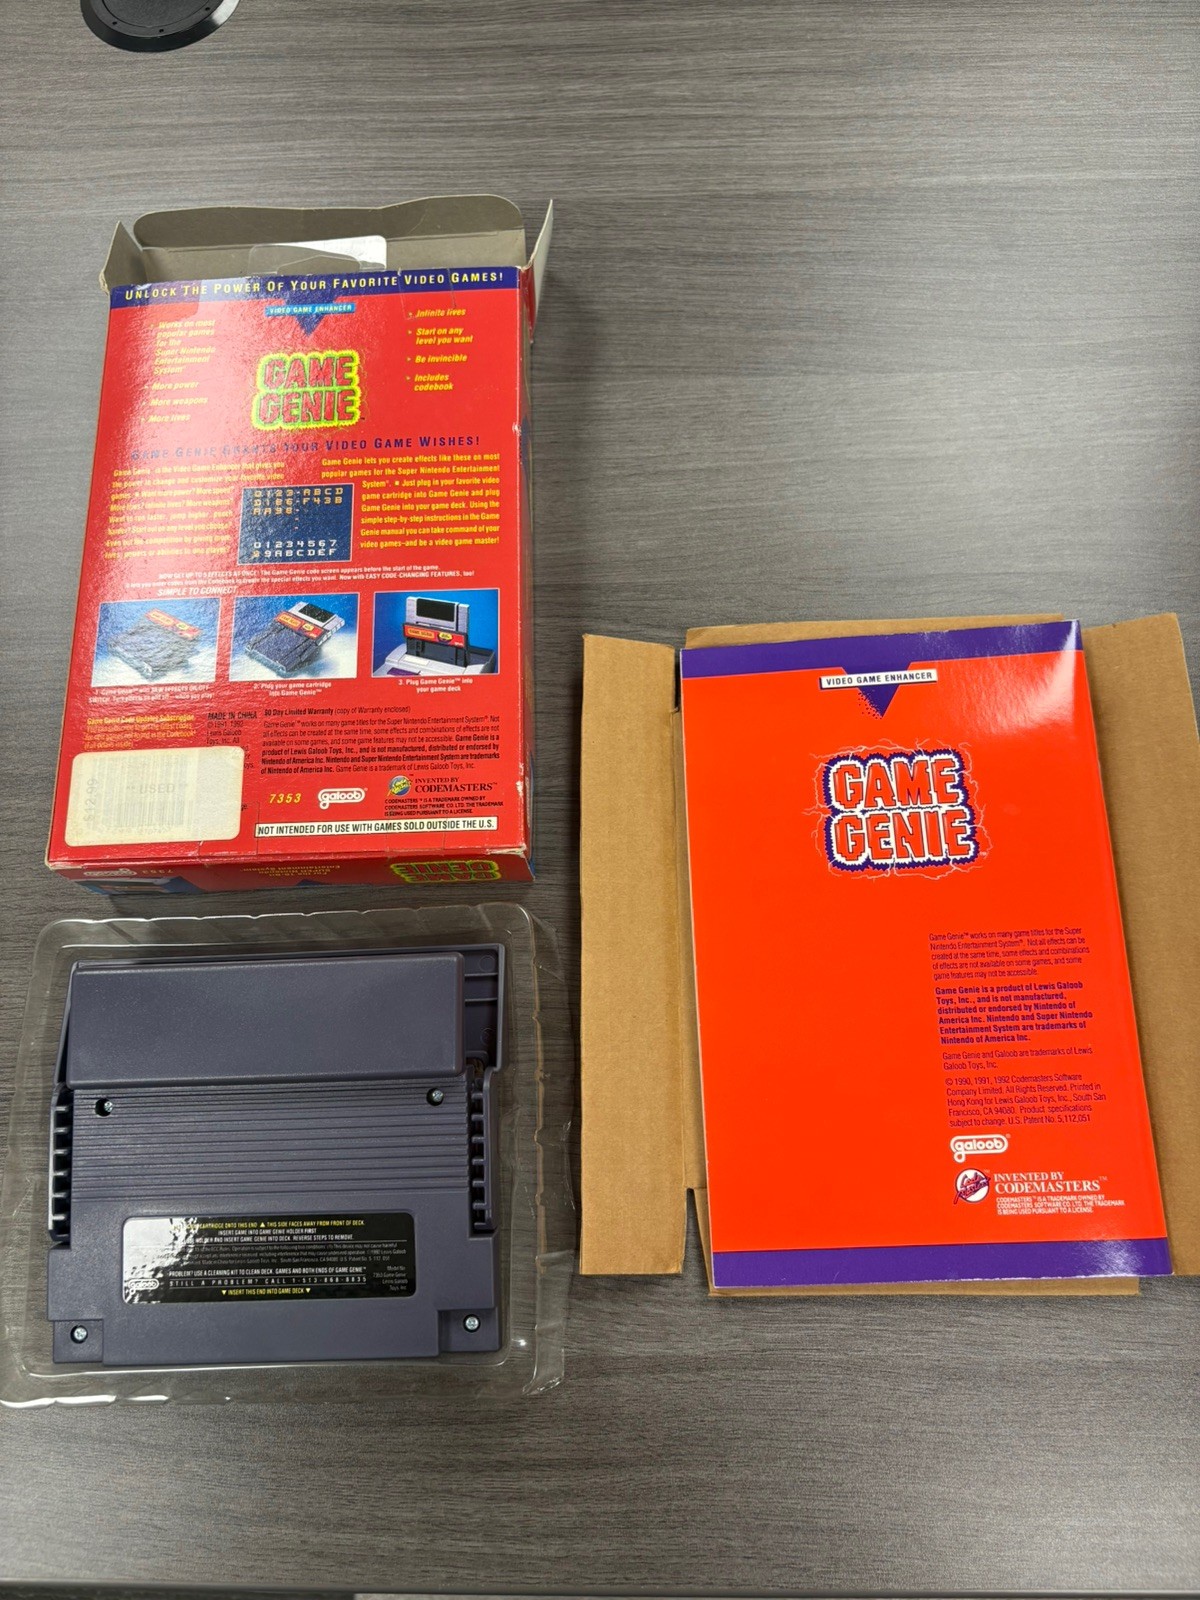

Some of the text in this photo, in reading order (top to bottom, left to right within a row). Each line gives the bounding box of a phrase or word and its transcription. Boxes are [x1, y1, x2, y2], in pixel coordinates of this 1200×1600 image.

[125, 272, 504, 300] UNLOCK THE POWER OF YOUR FAVORITE VIDEO GAMES!
[416, 308, 466, 318] Infinite lives
[416, 327, 436, 336] Start
[448, 328, 464, 337] any
[416, 335, 473, 346] level you want
[415, 354, 467, 363] Be invincible
[260, 352, 356, 391] GAME
[414, 373, 449, 382] Includes
[413, 383, 453, 391] codebook
[256, 389, 357, 429] GENIE
[282, 442, 319, 453] YOUR
[326, 439, 367, 451] VIDEO
[374, 438, 412, 449] GAME
[419, 436, 480, 447] WISHES!
[322, 458, 341, 466] Game
[342, 457, 362, 465] Genie
[378, 458, 390, 466] you
[414, 455, 437, 463] effects
[438, 454, 451, 462] like
[452, 454, 472, 462] these
[482, 453, 500, 461] most
[321, 470, 347, 479] popular
[348, 470, 372, 478] games
[384, 468, 396, 476] the
[397, 468, 418, 477] Super
[451, 465, 500, 473] Entertainment
[360, 540, 378, 548] video
[434, 538, 453, 546] video
[157, 588, 186, 596] SIMPLE
[187, 587, 198, 595] TO
[825, 672, 933, 686] VIDEO GAME ENHANCER
[207, 712, 227, 720] MADE
[414, 776, 459, 785] INVENTED BY
[827, 753, 963, 812] GAME
[269, 793, 302, 804] 7353
[320, 789, 364, 810] galoob
[258, 820, 494, 835] NOT INTENDED FOR USE WITH GAMES SOLD OUTSIDE THE U.S.
[829, 808, 976, 867] GENIE
[935, 987, 957, 995] Game
[958, 986, 980, 994] Genie
[996, 984, 1024, 994] product
[1033, 982, 1055, 990] Lewis
[1056, 981, 1083, 990] Galoob
[938, 1016, 969, 1024] America
[986, 1014, 1019, 1022] Nintendo
[1020, 1013, 1034, 1021] and
[1036, 1012, 1058, 1022] Super
[1059, 1010, 1093, 1019] Nintendo
[940, 1025, 991, 1034] Entertainment
[992, 1024, 1020, 1034] System
[1035, 1021, 1077, 1030] trademarks
[952, 1135, 1007, 1162] galoob
[993, 1171, 1064, 1182] INVENTED BY
